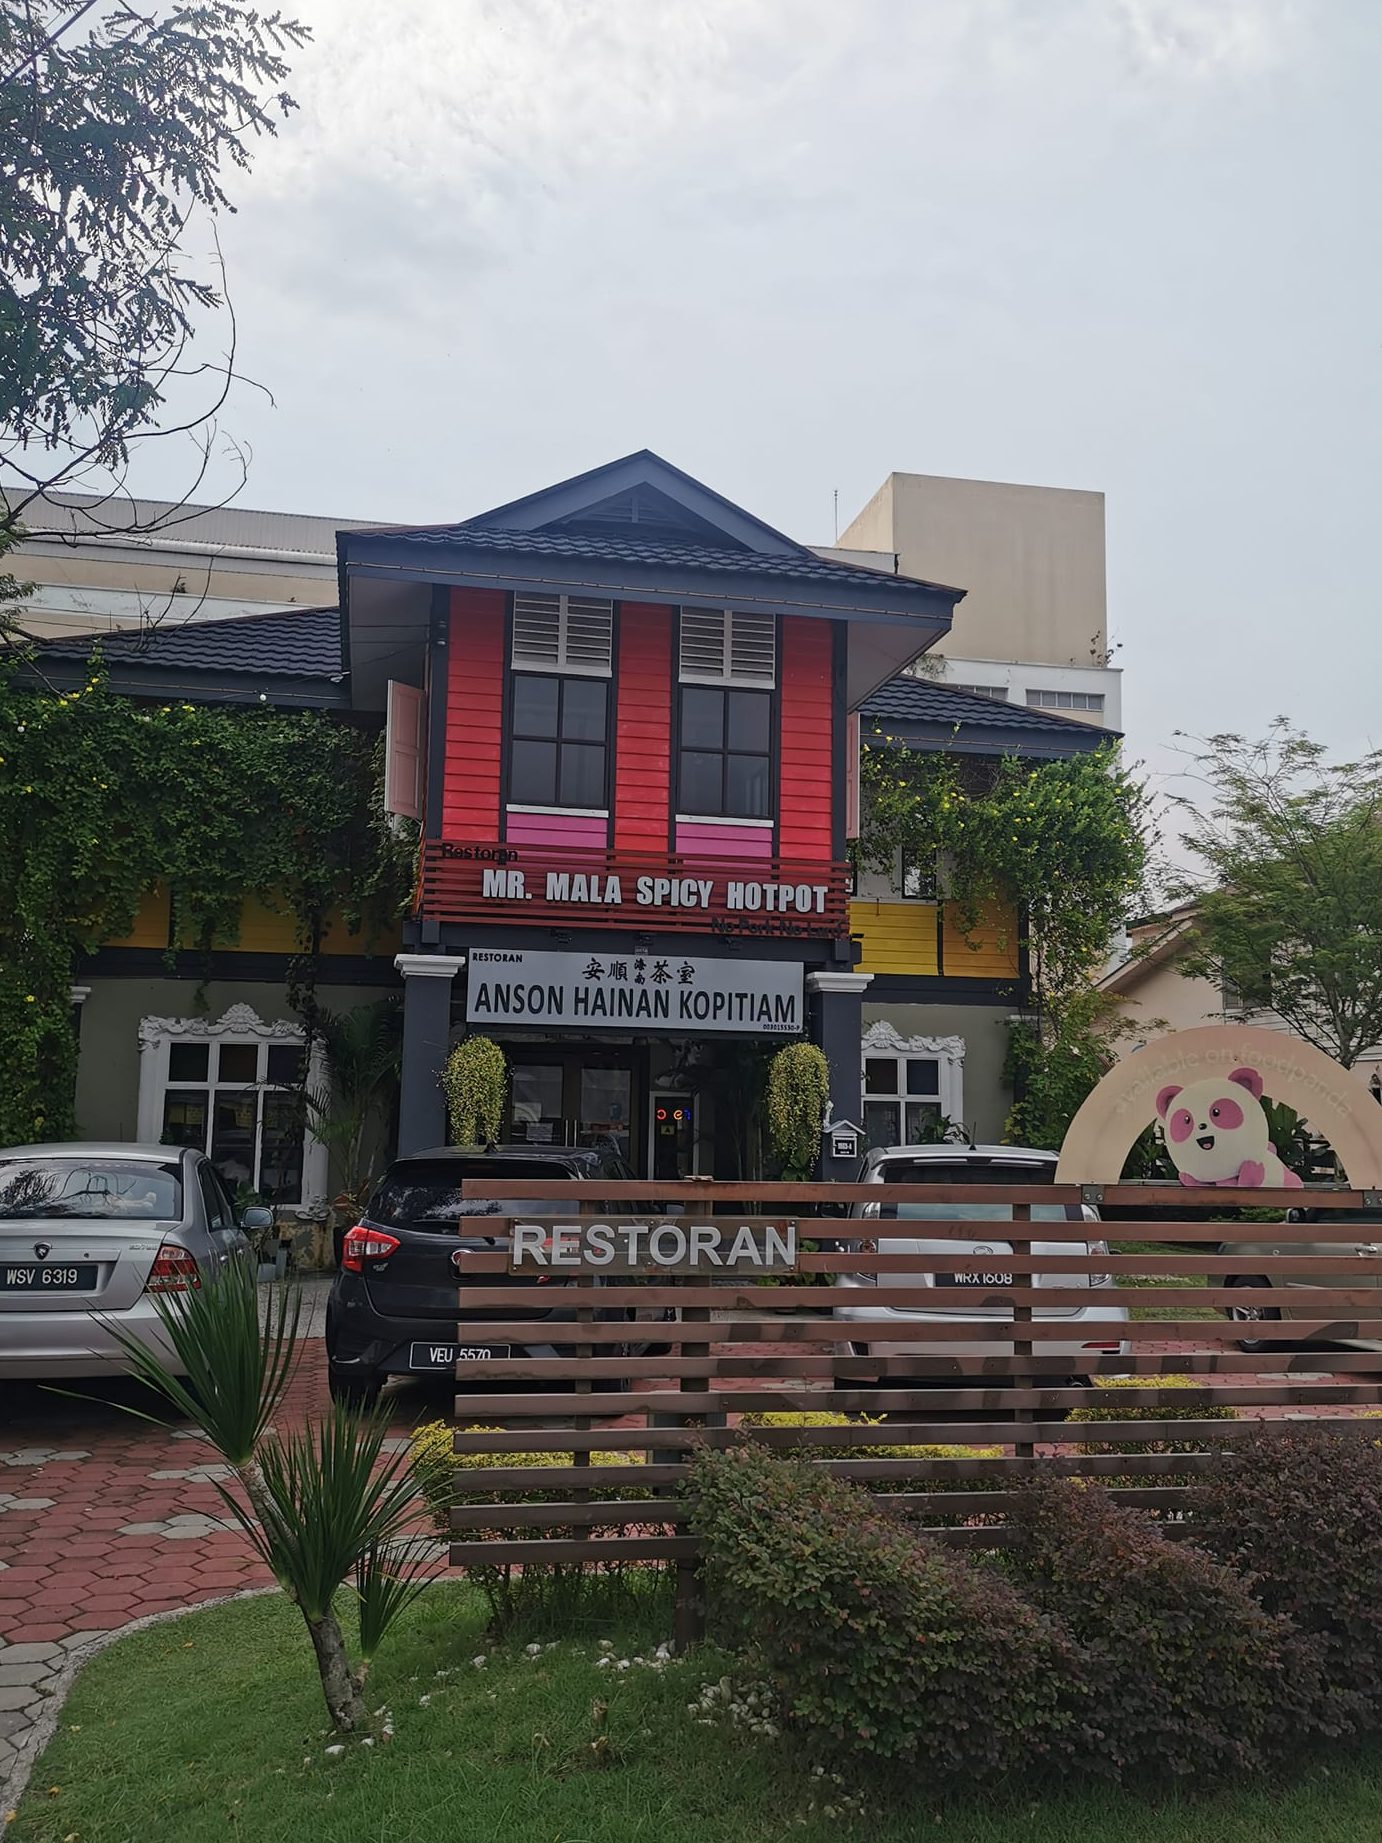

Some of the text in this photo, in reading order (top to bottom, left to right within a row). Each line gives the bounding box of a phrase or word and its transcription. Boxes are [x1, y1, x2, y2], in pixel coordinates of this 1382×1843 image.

[482, 868, 828, 913] MR. MALA SPICY HOTPOT
[472, 952, 523, 963] RESTORAN
[474, 983, 795, 1023] ANSON HAINAN KOPITIAM
[1206, 1048, 1234, 1061] on
[512, 1224, 796, 1266] RESTORAN
[6, 1268, 78, 1285] WSV 6319
[954, 1273, 981, 1284] WRX
[429, 1347, 491, 1362] VEU 5570
